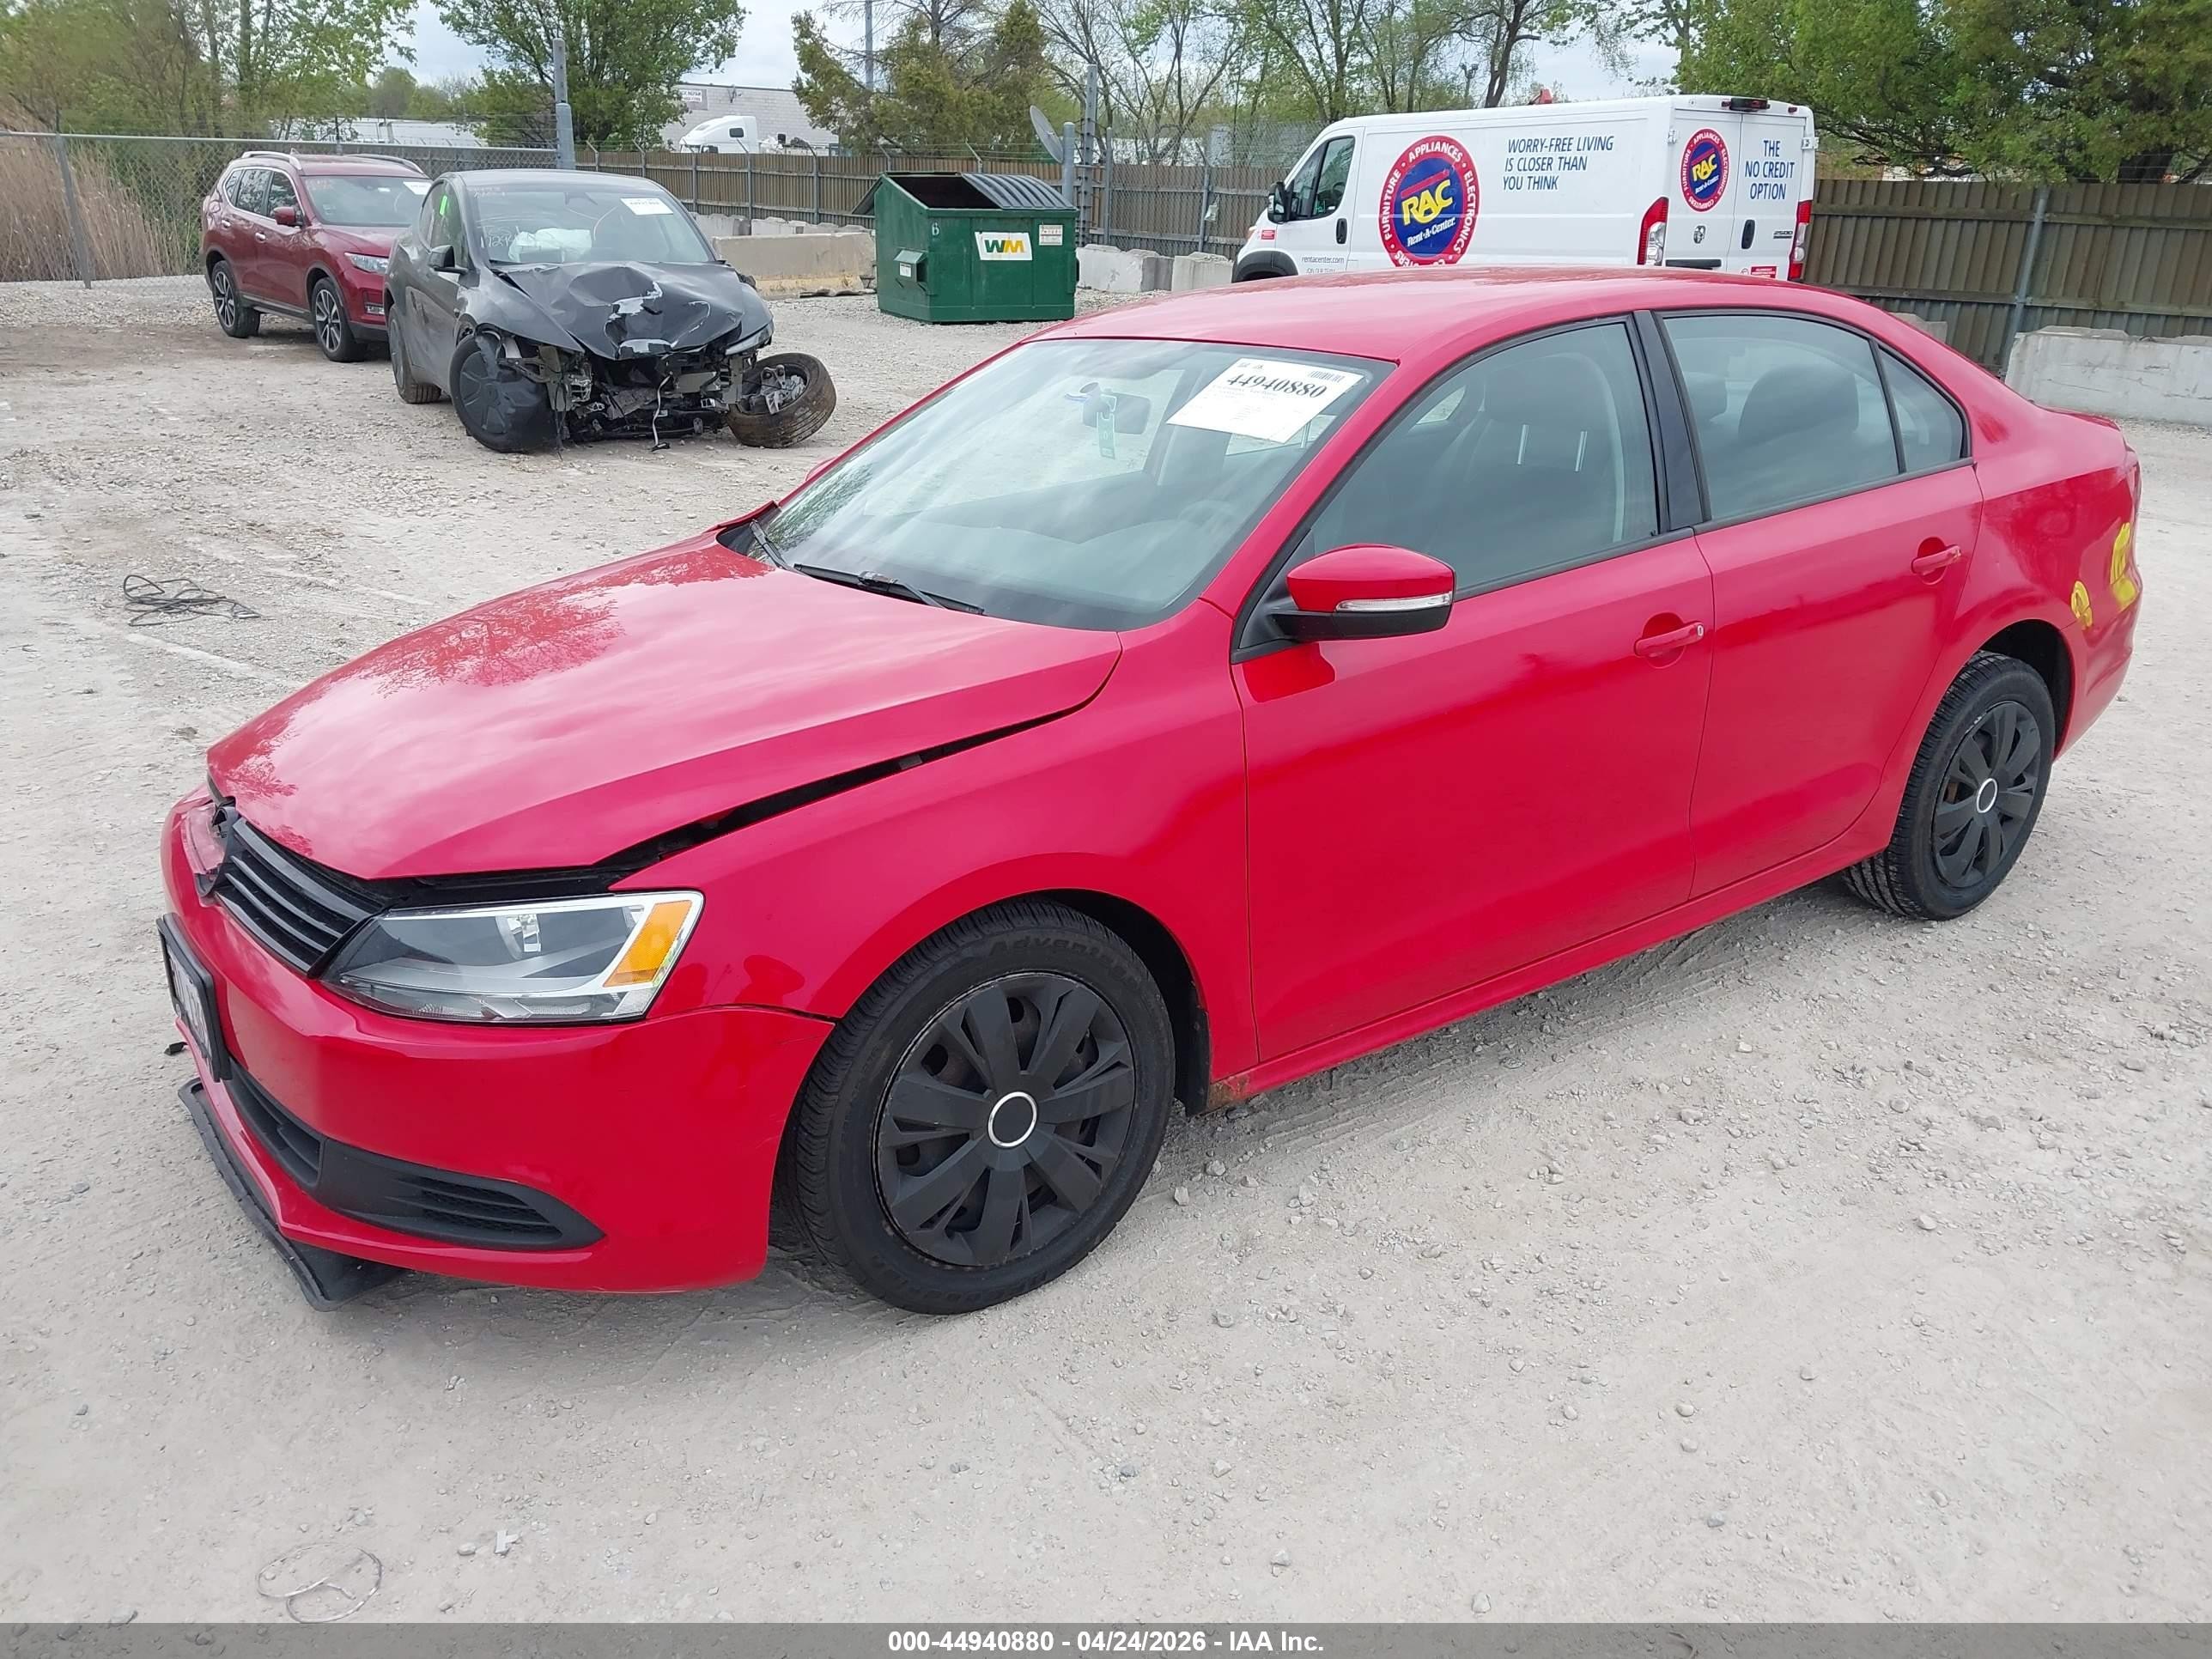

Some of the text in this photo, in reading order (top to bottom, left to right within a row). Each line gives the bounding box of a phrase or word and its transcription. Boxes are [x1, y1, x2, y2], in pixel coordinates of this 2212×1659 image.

[1508, 136, 1614, 153] WORRY-FREE LIVING
[1693, 132, 1720, 145] APPLIANCES
[1408, 142, 1463, 162] APPLIANCES
[1763, 140, 1780, 157] THE
[1505, 156, 1588, 172] IS CLOSER THAN
[1682, 149, 1692, 191] FURNITURE
[1692, 154, 1717, 181] RAC
[1717, 148, 1729, 196] ELECTRONICS
[1745, 161, 1795, 179] NO CREDIT
[1503, 175, 1559, 190] YOU THINK
[1750, 183, 1787, 199] OPTION
[1381, 169, 1402, 241] FURNITURE
[1401, 179, 1453, 226] RAC
[1453, 170, 1476, 253] ELECTRONICS
[984, 240, 1024, 253] WM
[1227, 374, 1328, 398] 44940880
